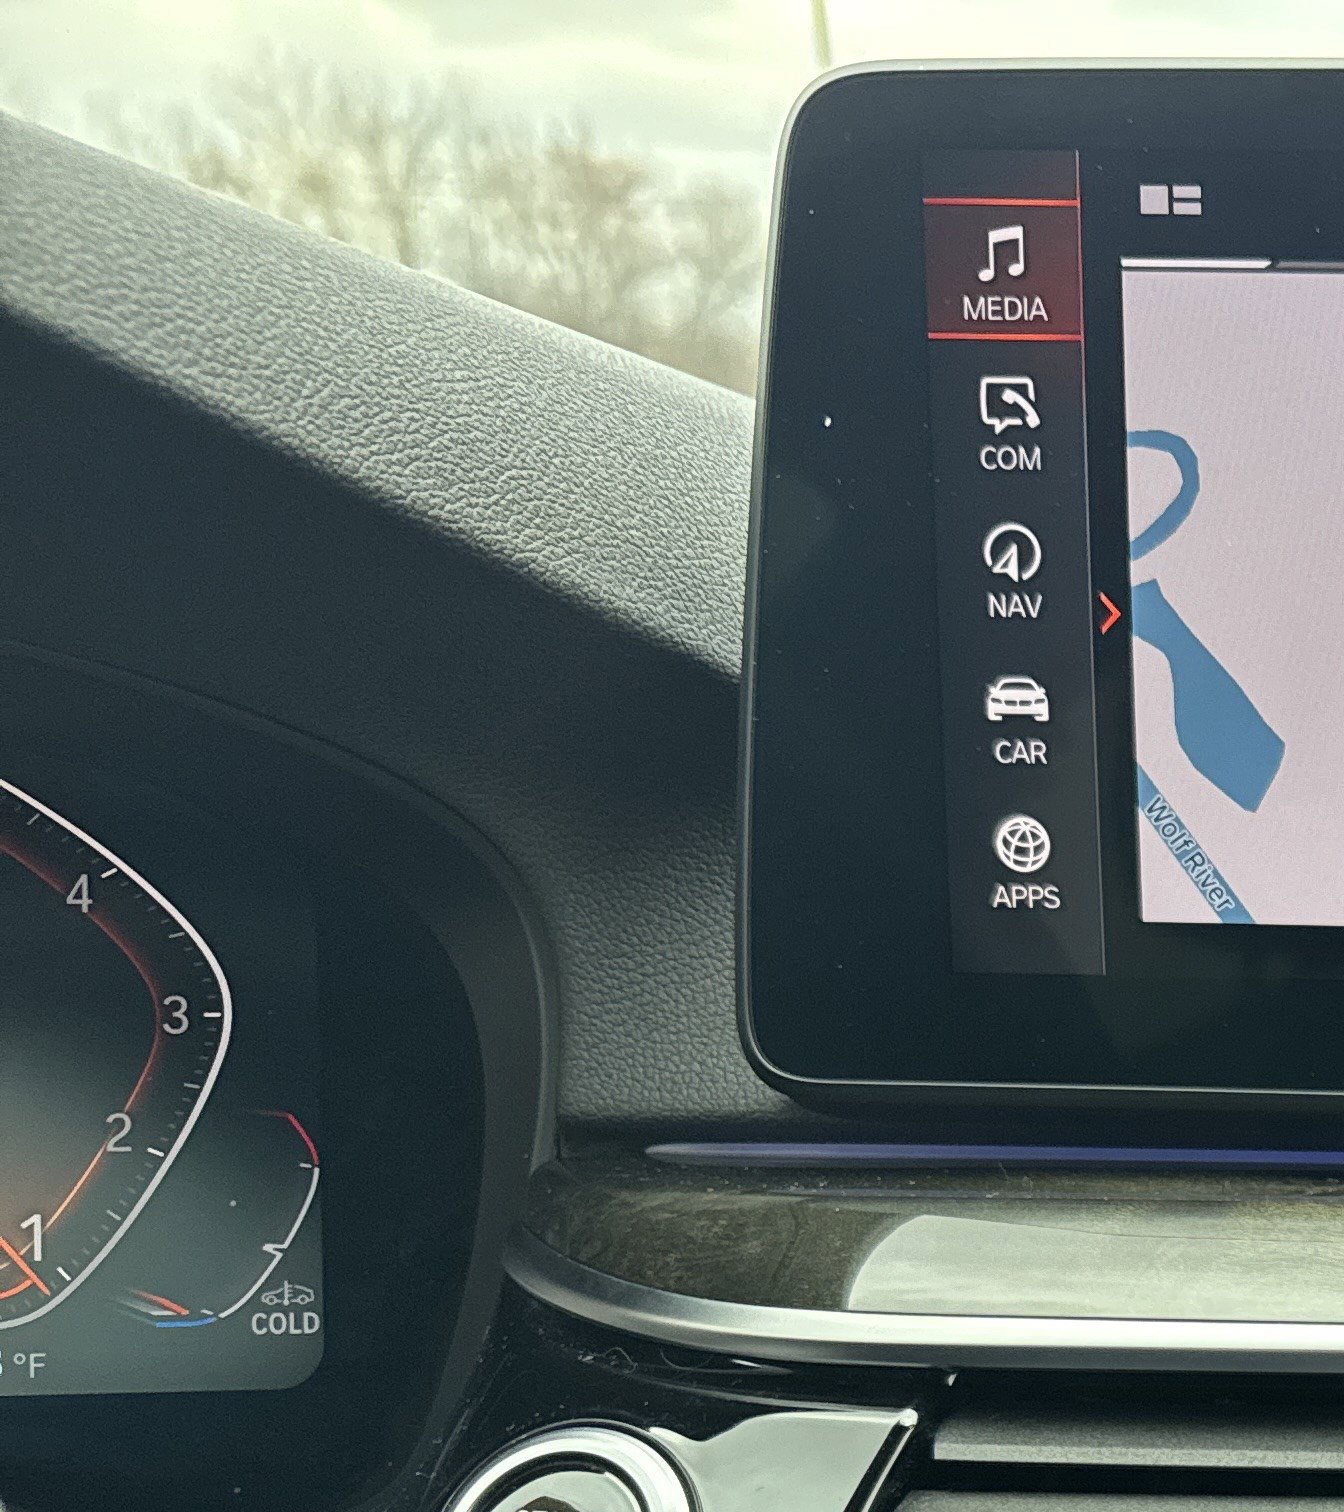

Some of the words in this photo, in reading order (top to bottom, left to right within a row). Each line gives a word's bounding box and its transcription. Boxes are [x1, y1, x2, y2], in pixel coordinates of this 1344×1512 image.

[962, 296, 1048, 322] MEDIA
[980, 446, 1041, 471] COM
[988, 594, 1043, 618] NAV
[995, 741, 1048, 765] CAR
[1145, 794, 1192, 856] Wolf
[1184, 849, 1236, 912] River
[66, 873, 93, 913] 4
[992, 885, 1061, 909] APPS
[162, 996, 189, 1035] 3
[106, 1112, 133, 1152] 2
[20, 1214, 43, 1261] 1
[251, 1313, 320, 1335] COLD
